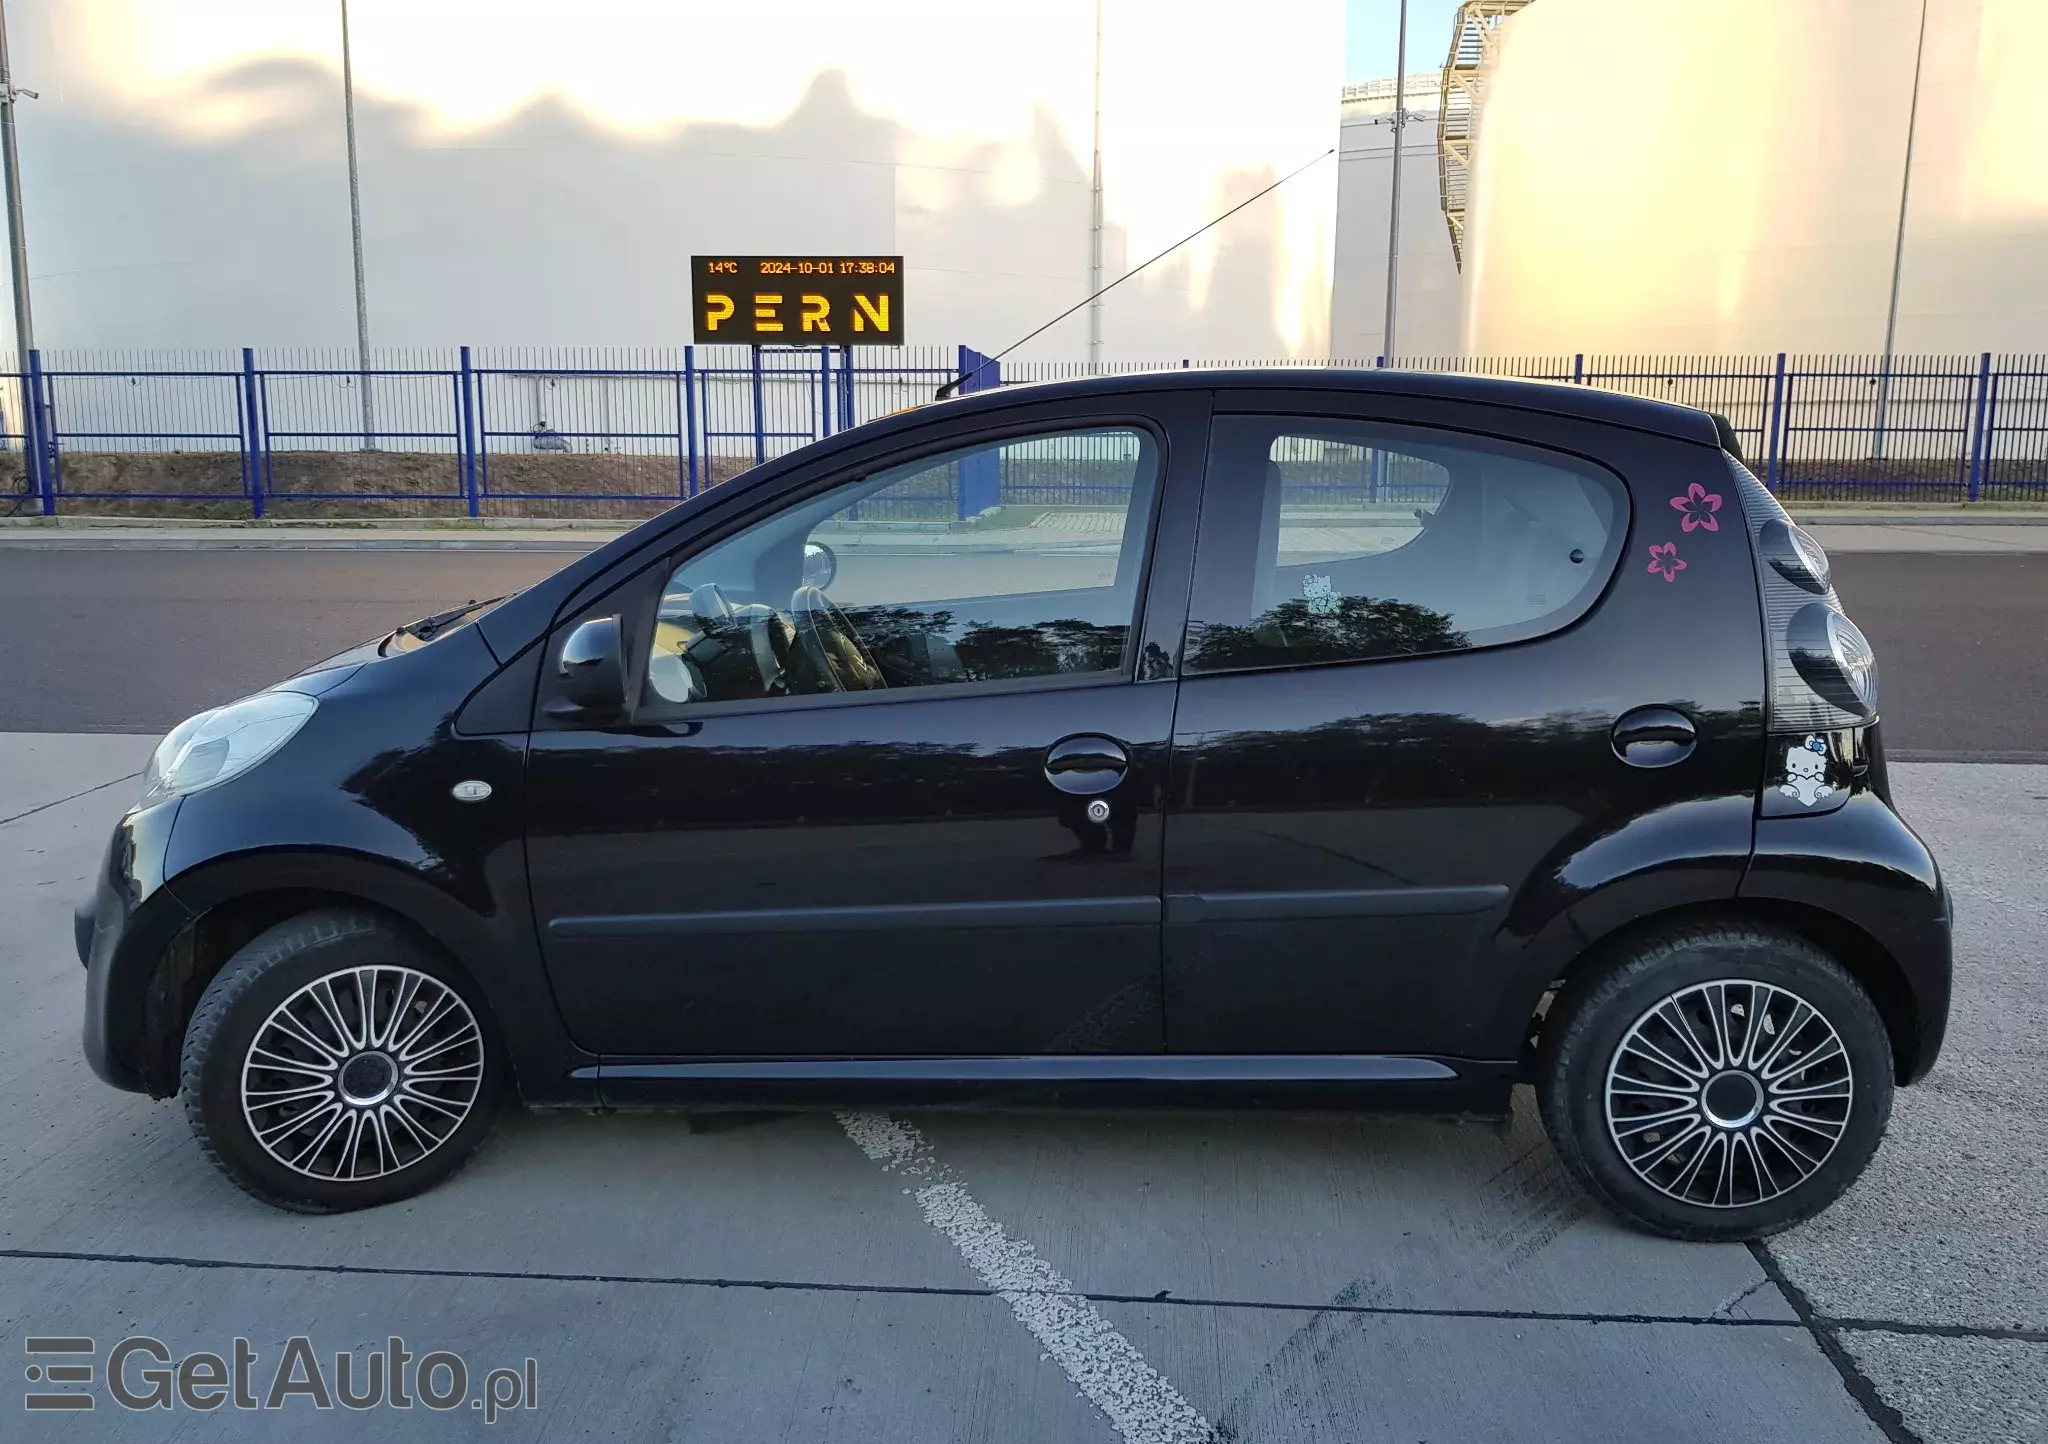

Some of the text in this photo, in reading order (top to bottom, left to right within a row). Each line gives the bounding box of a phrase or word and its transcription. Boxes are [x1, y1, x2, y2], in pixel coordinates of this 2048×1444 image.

[708, 262, 895, 274] 14°C 2024-10-01 17:38:04
[706, 295, 890, 332] PERN
